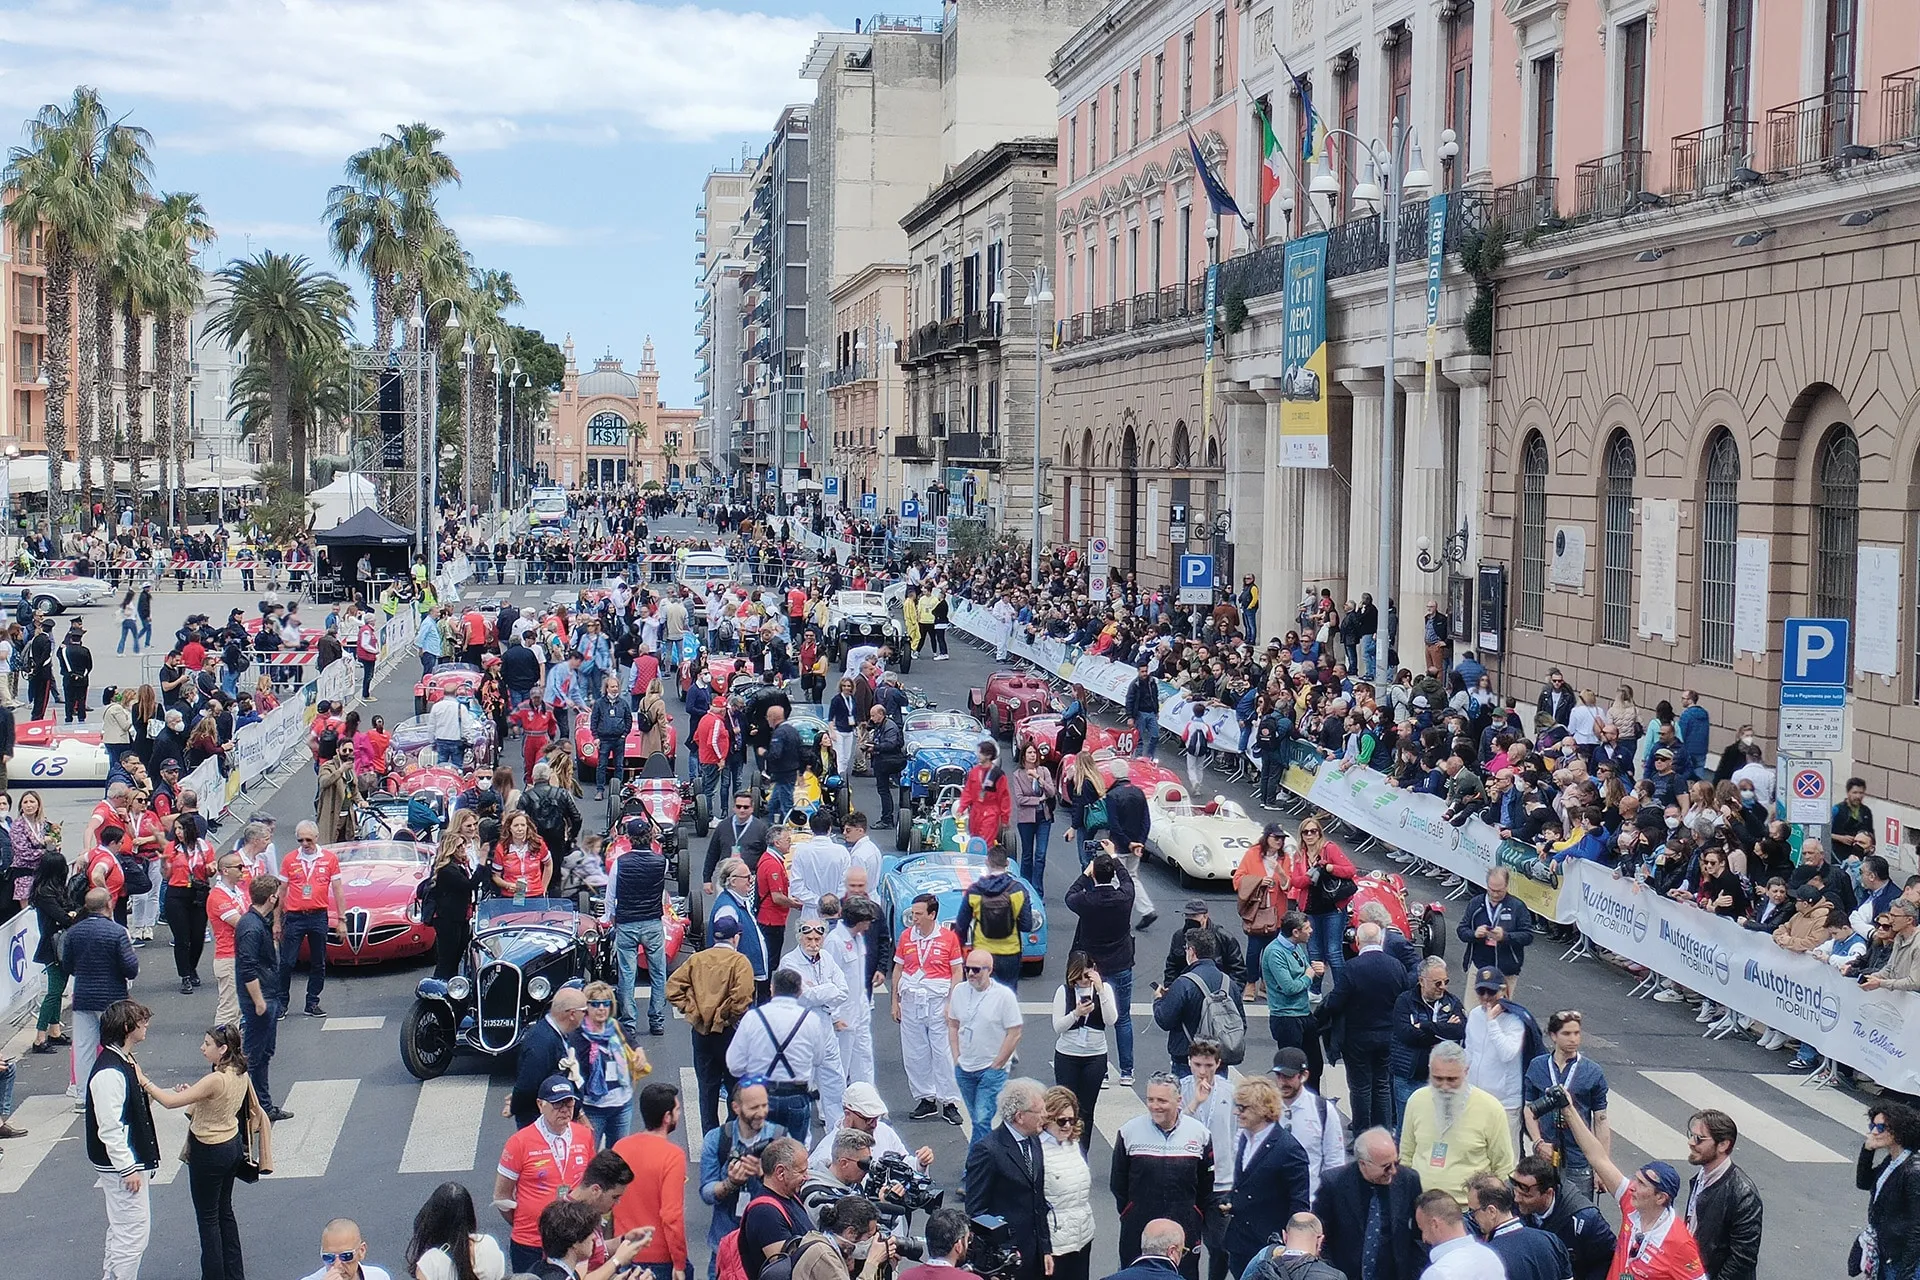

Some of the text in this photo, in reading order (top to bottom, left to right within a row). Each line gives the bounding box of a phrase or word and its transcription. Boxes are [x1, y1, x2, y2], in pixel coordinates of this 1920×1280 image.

[1430, 211, 1443, 255] BARI
[1429, 262, 1439, 280] DI
[767, 471, 774, 479] P
[827, 479, 835, 489] P
[905, 503, 914, 515] P
[1172, 506, 1184, 520] T
[1187, 559, 1206, 584] P
[1796, 625, 1834, 677] P
[1117, 732, 1133, 753] 46
[31, 757, 68, 776] 63
[1220, 837, 1252, 848] 26
[1583, 884, 1635, 925] Autotrend
[1664, 920, 1718, 965] Autotrend
[1752, 962, 1822, 1010] Autotrend
[1853, 1021, 1867, 1039] The
